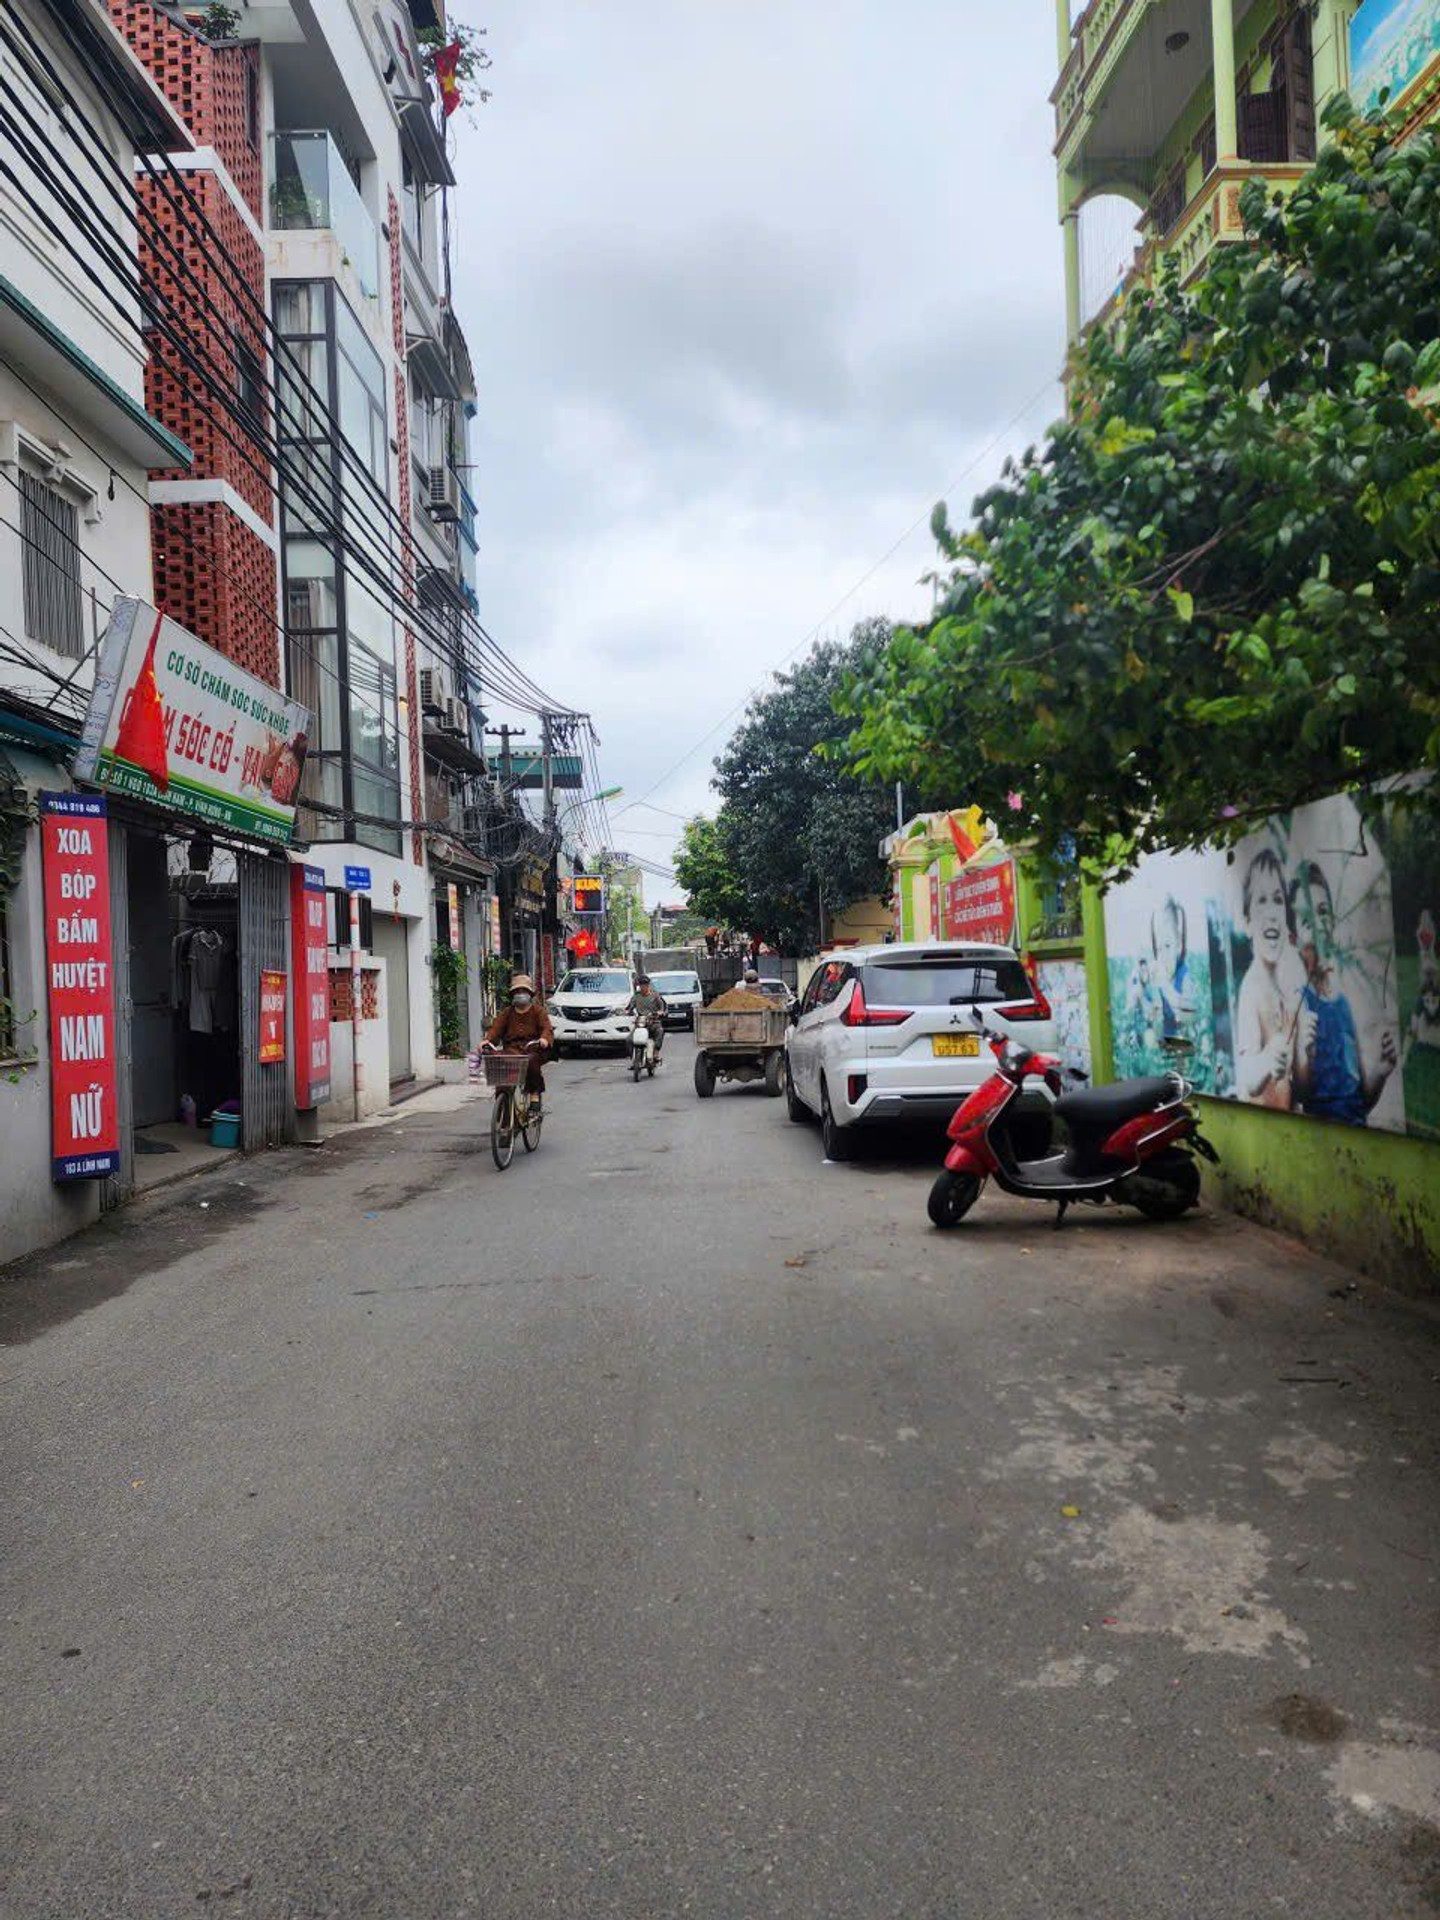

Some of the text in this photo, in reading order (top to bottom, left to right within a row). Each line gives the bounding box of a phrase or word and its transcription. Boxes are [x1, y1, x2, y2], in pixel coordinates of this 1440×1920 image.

[167, 651, 185, 676] CƠ
[231, 688, 250, 713] SÓC
[174, 712, 212, 765] SÓC
[57, 828, 93, 855] XOA
[61, 868, 96, 899] BÓP
[57, 908, 97, 943] BẤM
[52, 957, 106, 993] HUYỆT
[60, 1014, 105, 1061] NAM
[70, 1082, 104, 1139] NỮ
